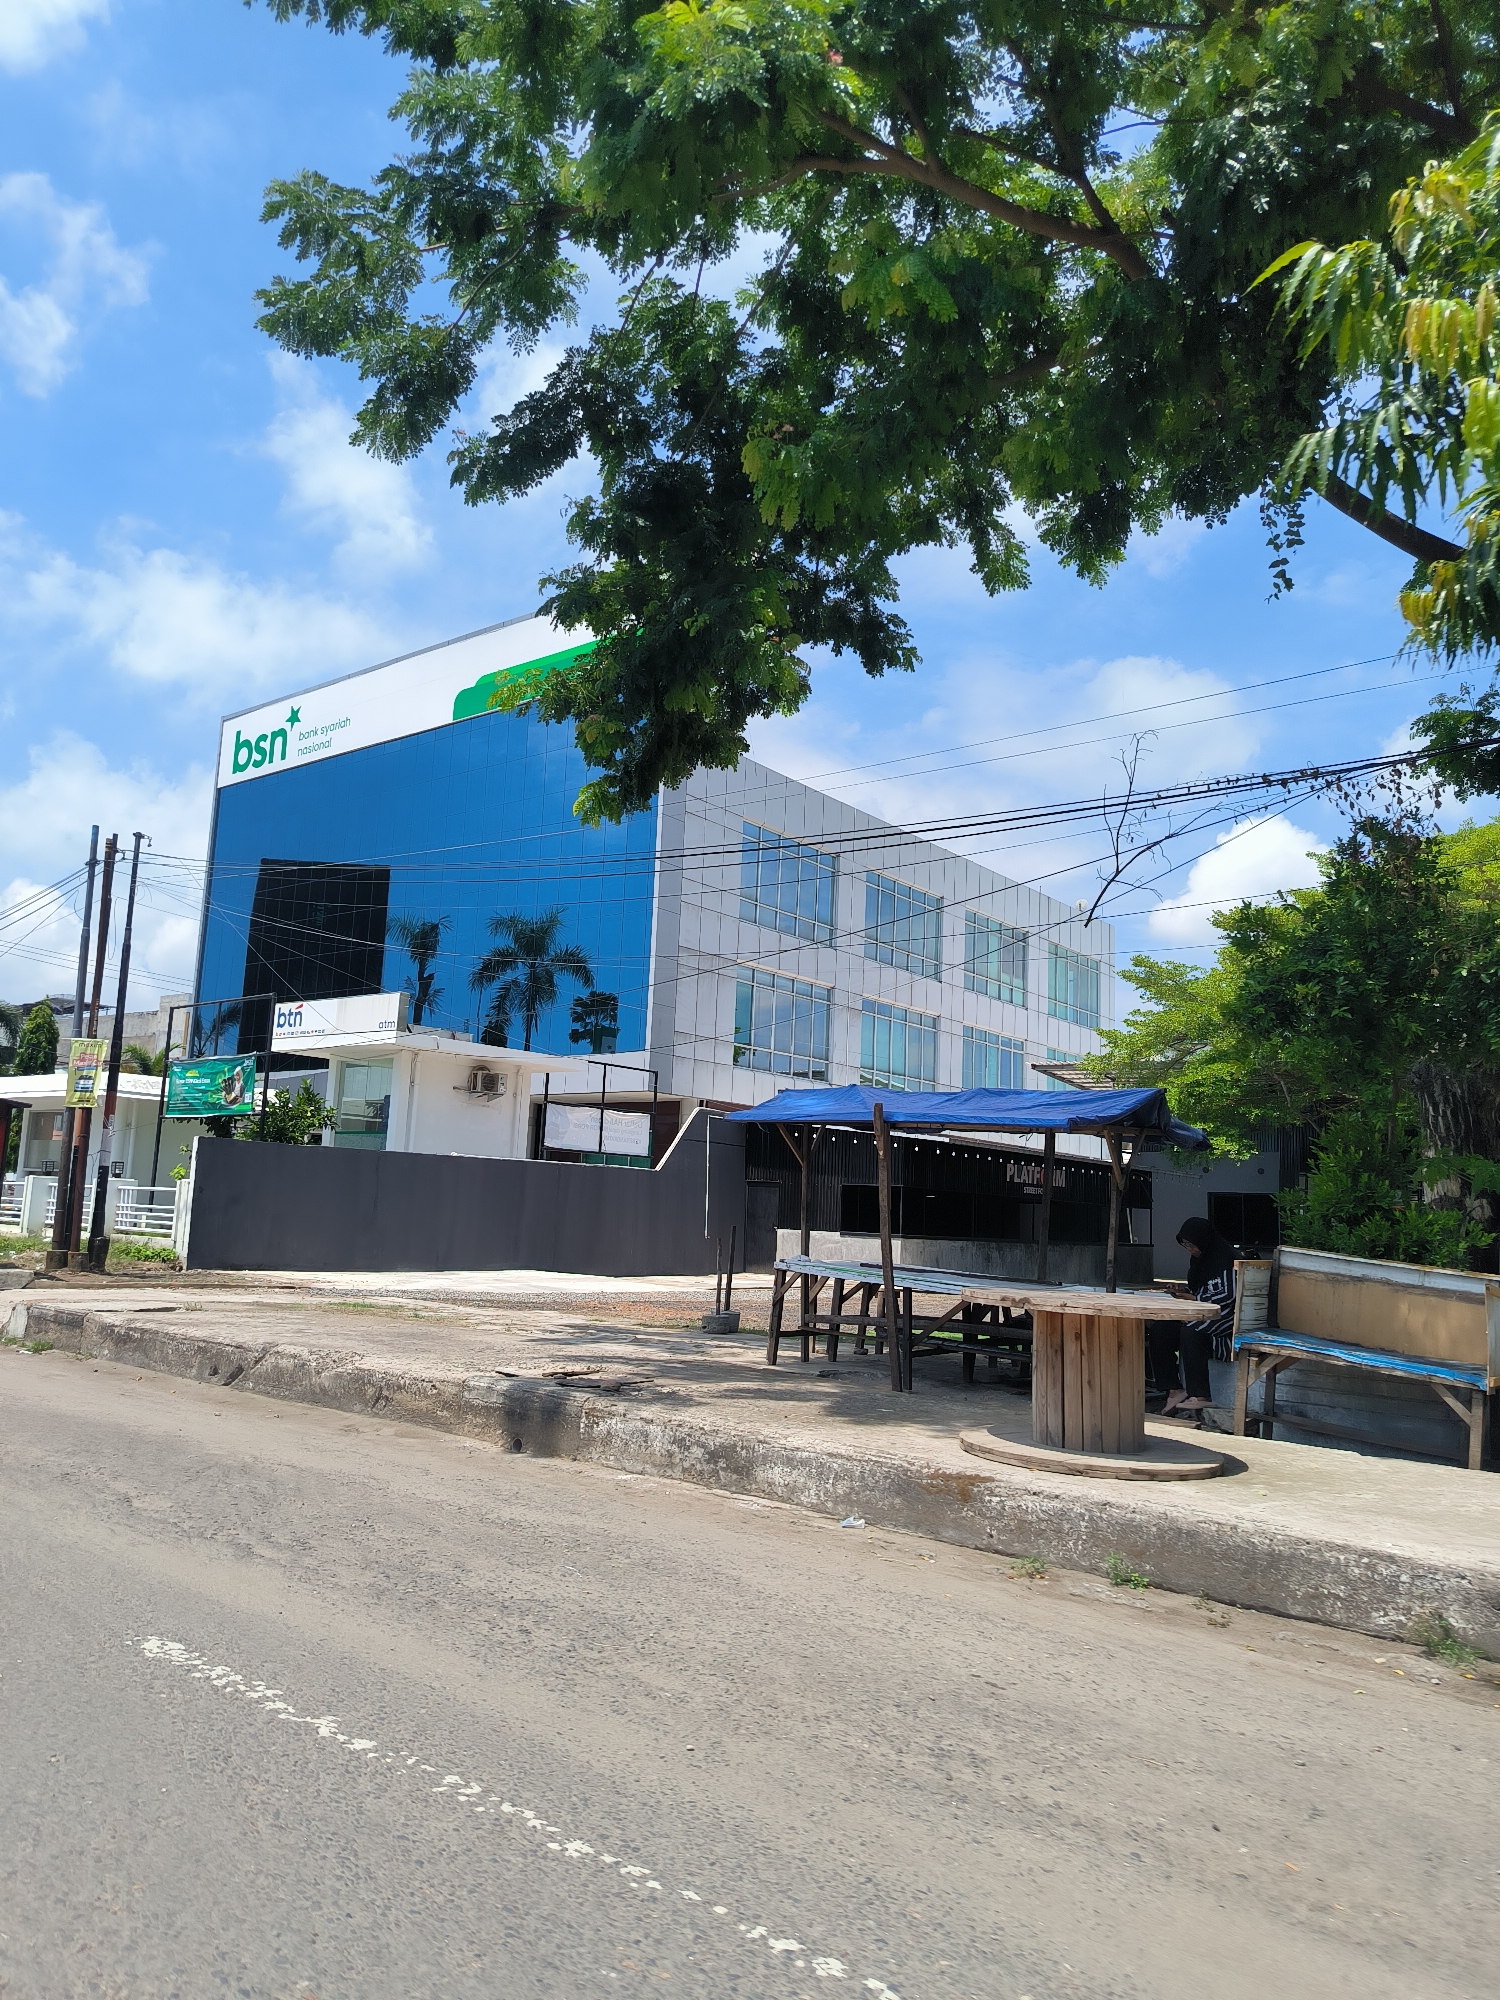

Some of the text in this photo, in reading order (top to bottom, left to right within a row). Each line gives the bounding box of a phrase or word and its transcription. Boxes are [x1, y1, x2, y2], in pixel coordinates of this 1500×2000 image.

[298, 717, 351, 741] bank syariah
[232, 728, 287, 774] bsn
[297, 737, 332, 757] nasional
[276, 1007, 303, 1029] btn
[378, 1019, 396, 1029] atm
